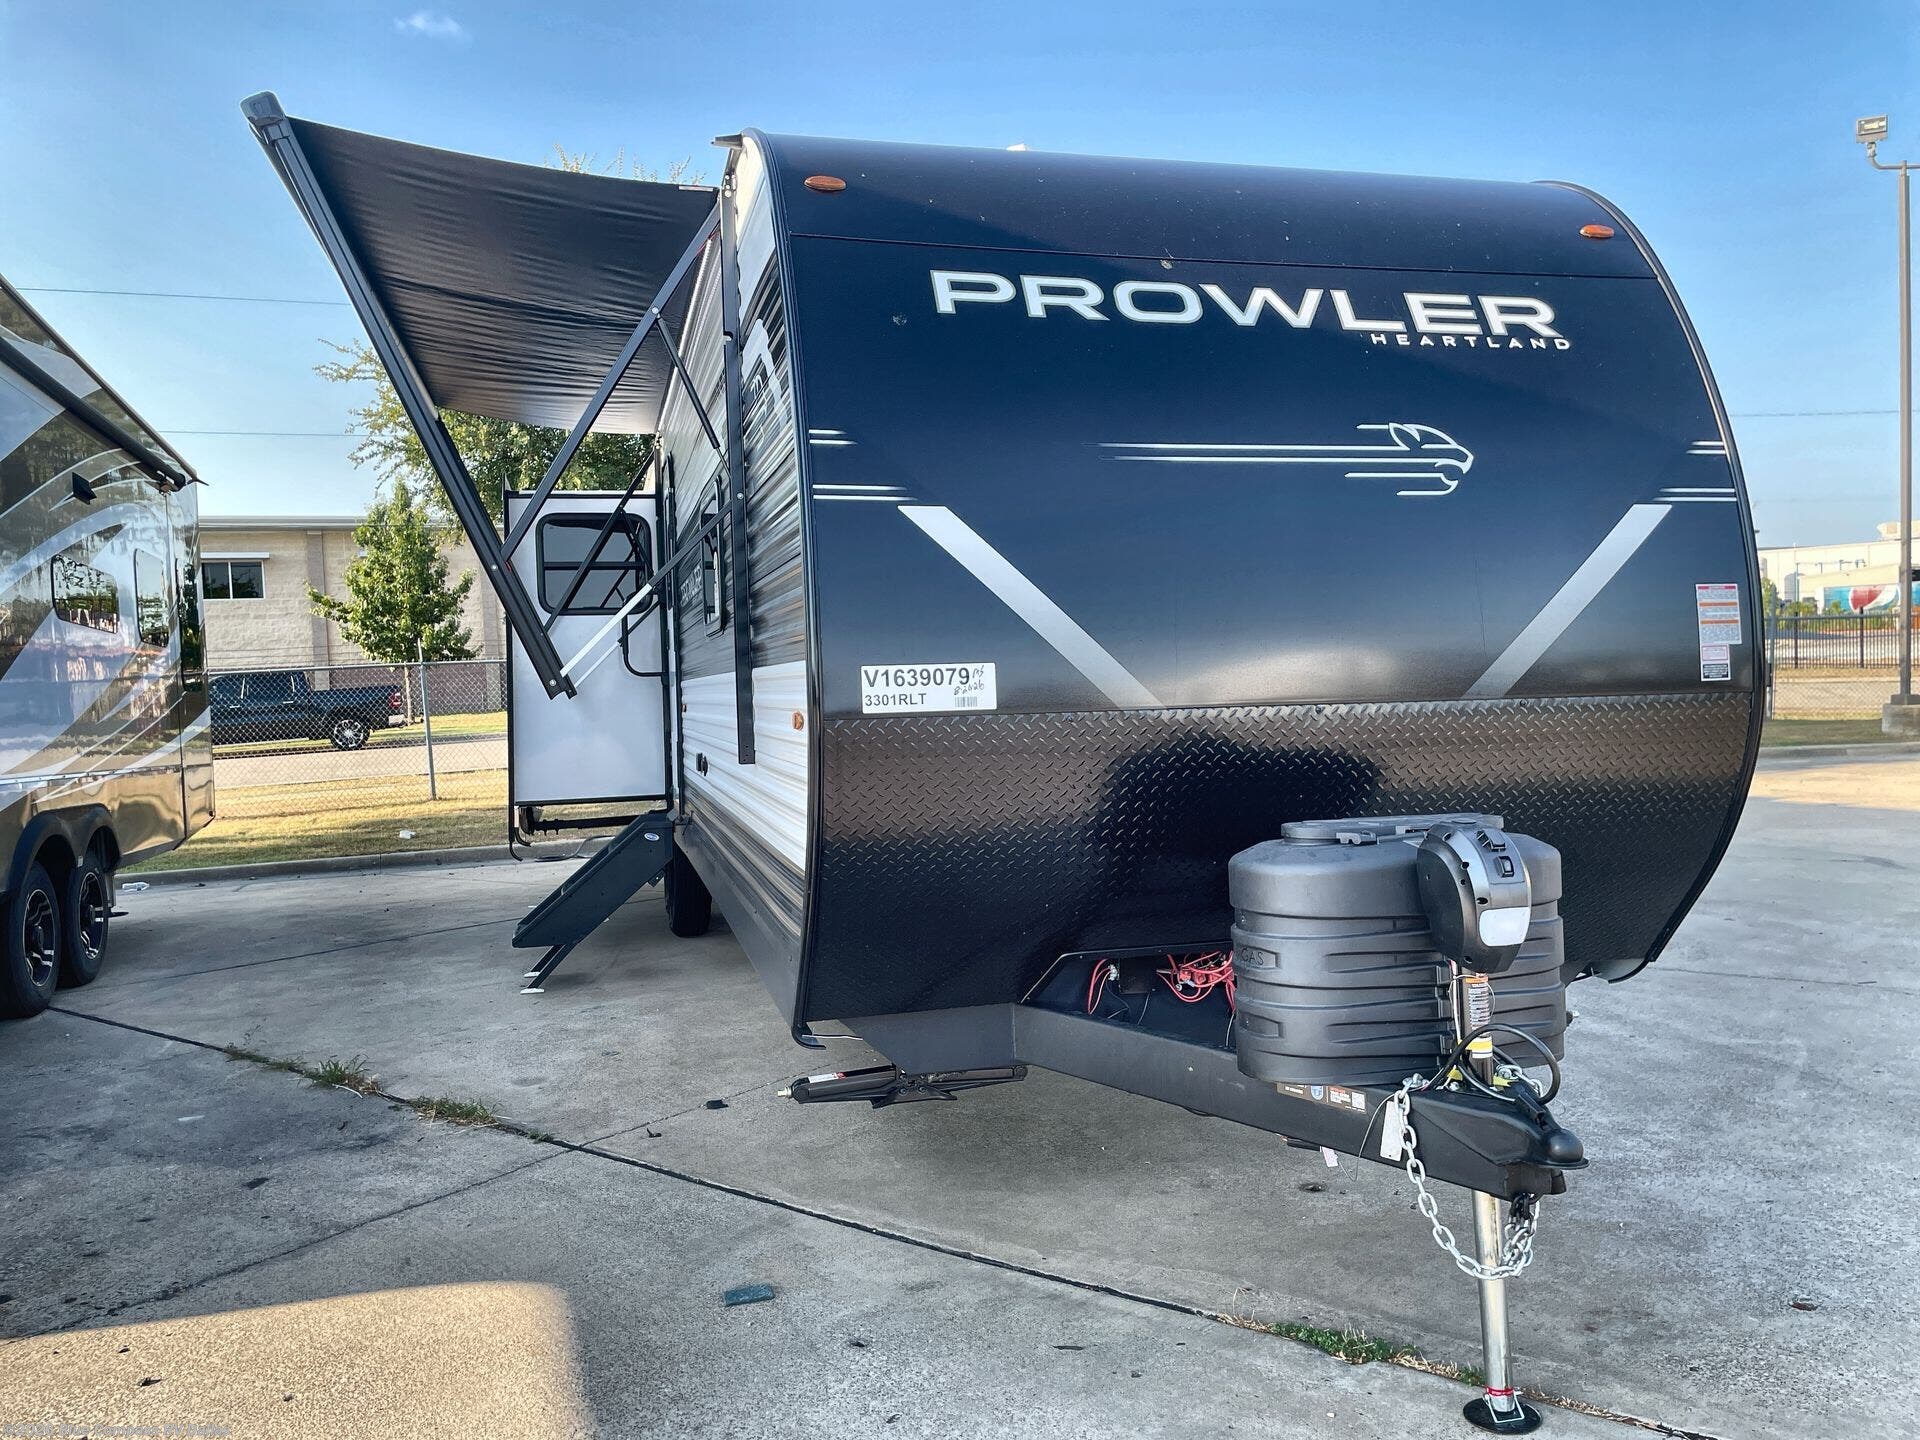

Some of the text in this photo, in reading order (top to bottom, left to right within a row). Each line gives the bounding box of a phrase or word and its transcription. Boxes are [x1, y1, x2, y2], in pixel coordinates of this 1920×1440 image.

[930, 270, 1564, 338] PROWLER
[1370, 333, 1571, 350] HEARTLAND
[864, 667, 970, 688] V1639079
[865, 693, 927, 706] 3301RLT
